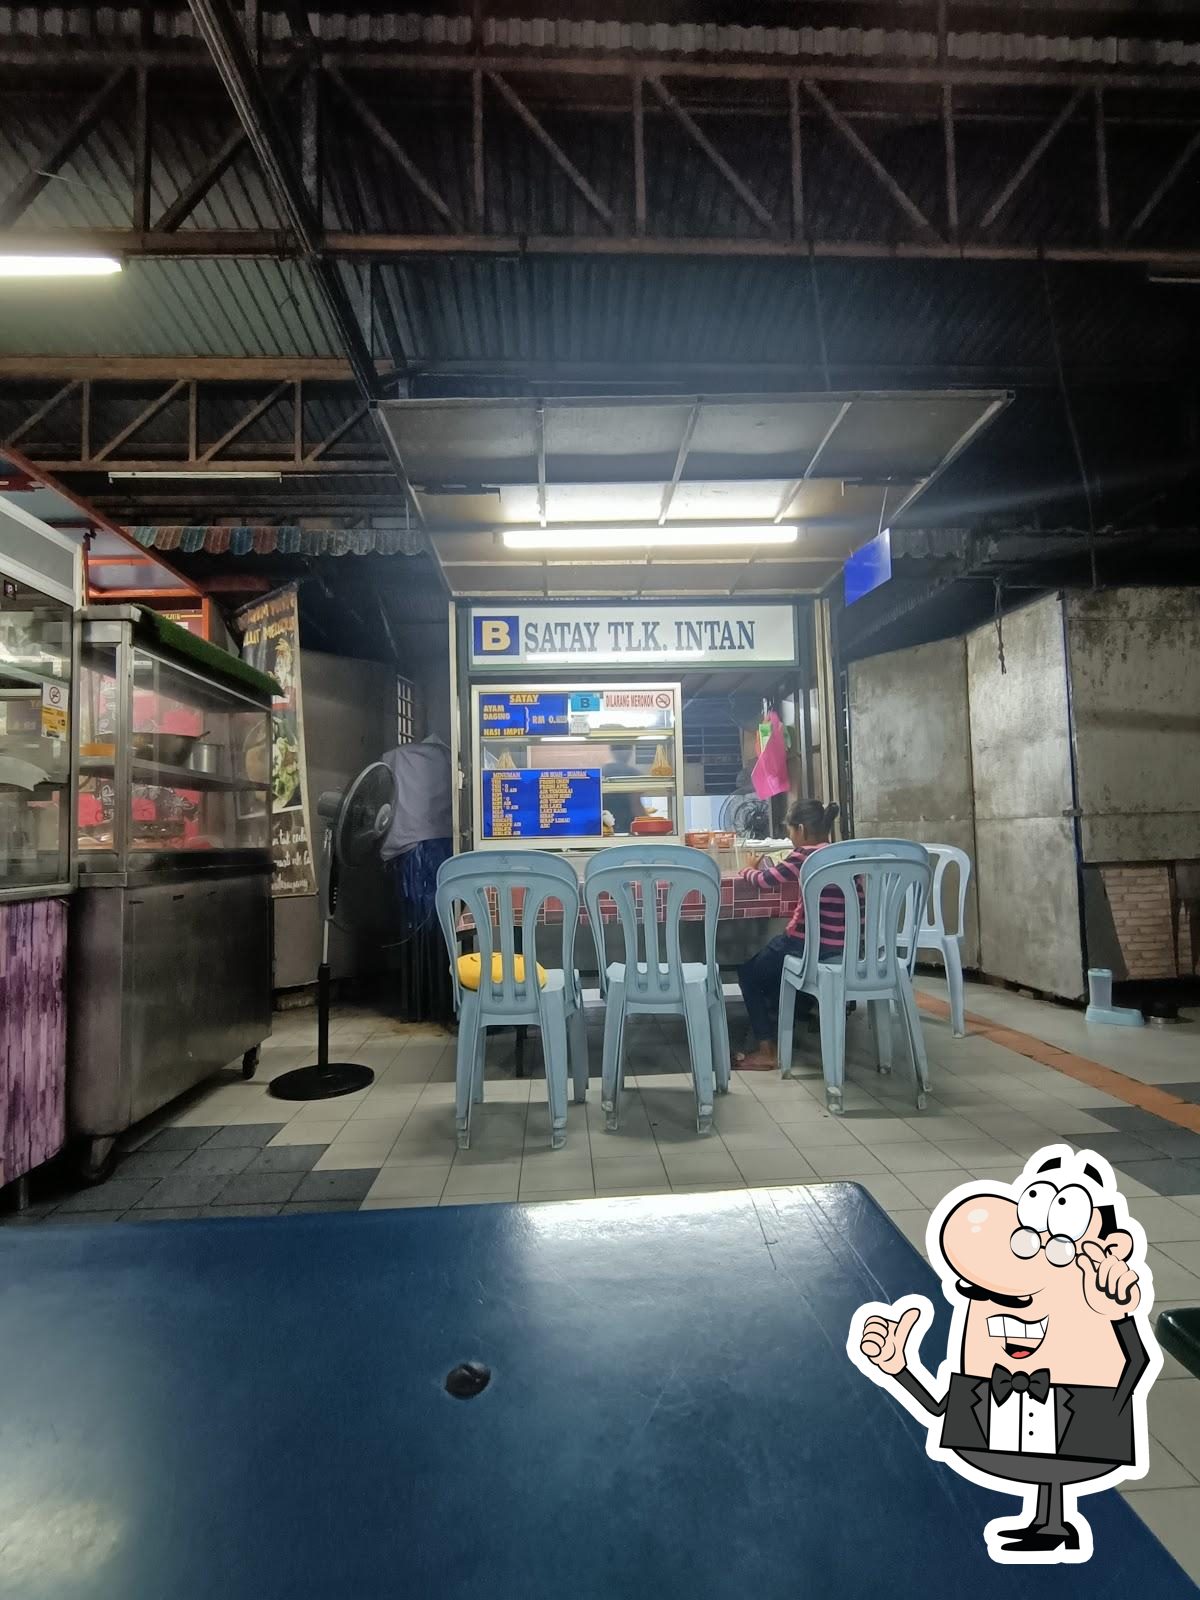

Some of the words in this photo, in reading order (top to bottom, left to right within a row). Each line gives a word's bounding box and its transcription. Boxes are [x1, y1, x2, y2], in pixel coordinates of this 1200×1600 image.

[481, 620, 511, 651] B
[524, 622, 600, 653] SATAY
[608, 621, 667, 652] TLK.
[674, 620, 756, 650] INTAN
[509, 693, 540, 703] SATAY
[581, 697, 590, 708] B
[606, 694, 630, 708] DILARANG
[630, 693, 654, 708] MEROKOK
[483, 704, 505, 713] AYAM
[483, 712, 511, 721] DAGING
[532, 715, 545, 724] RM
[483, 728, 501, 736] NASI
[503, 727, 525, 736] IMPIT
